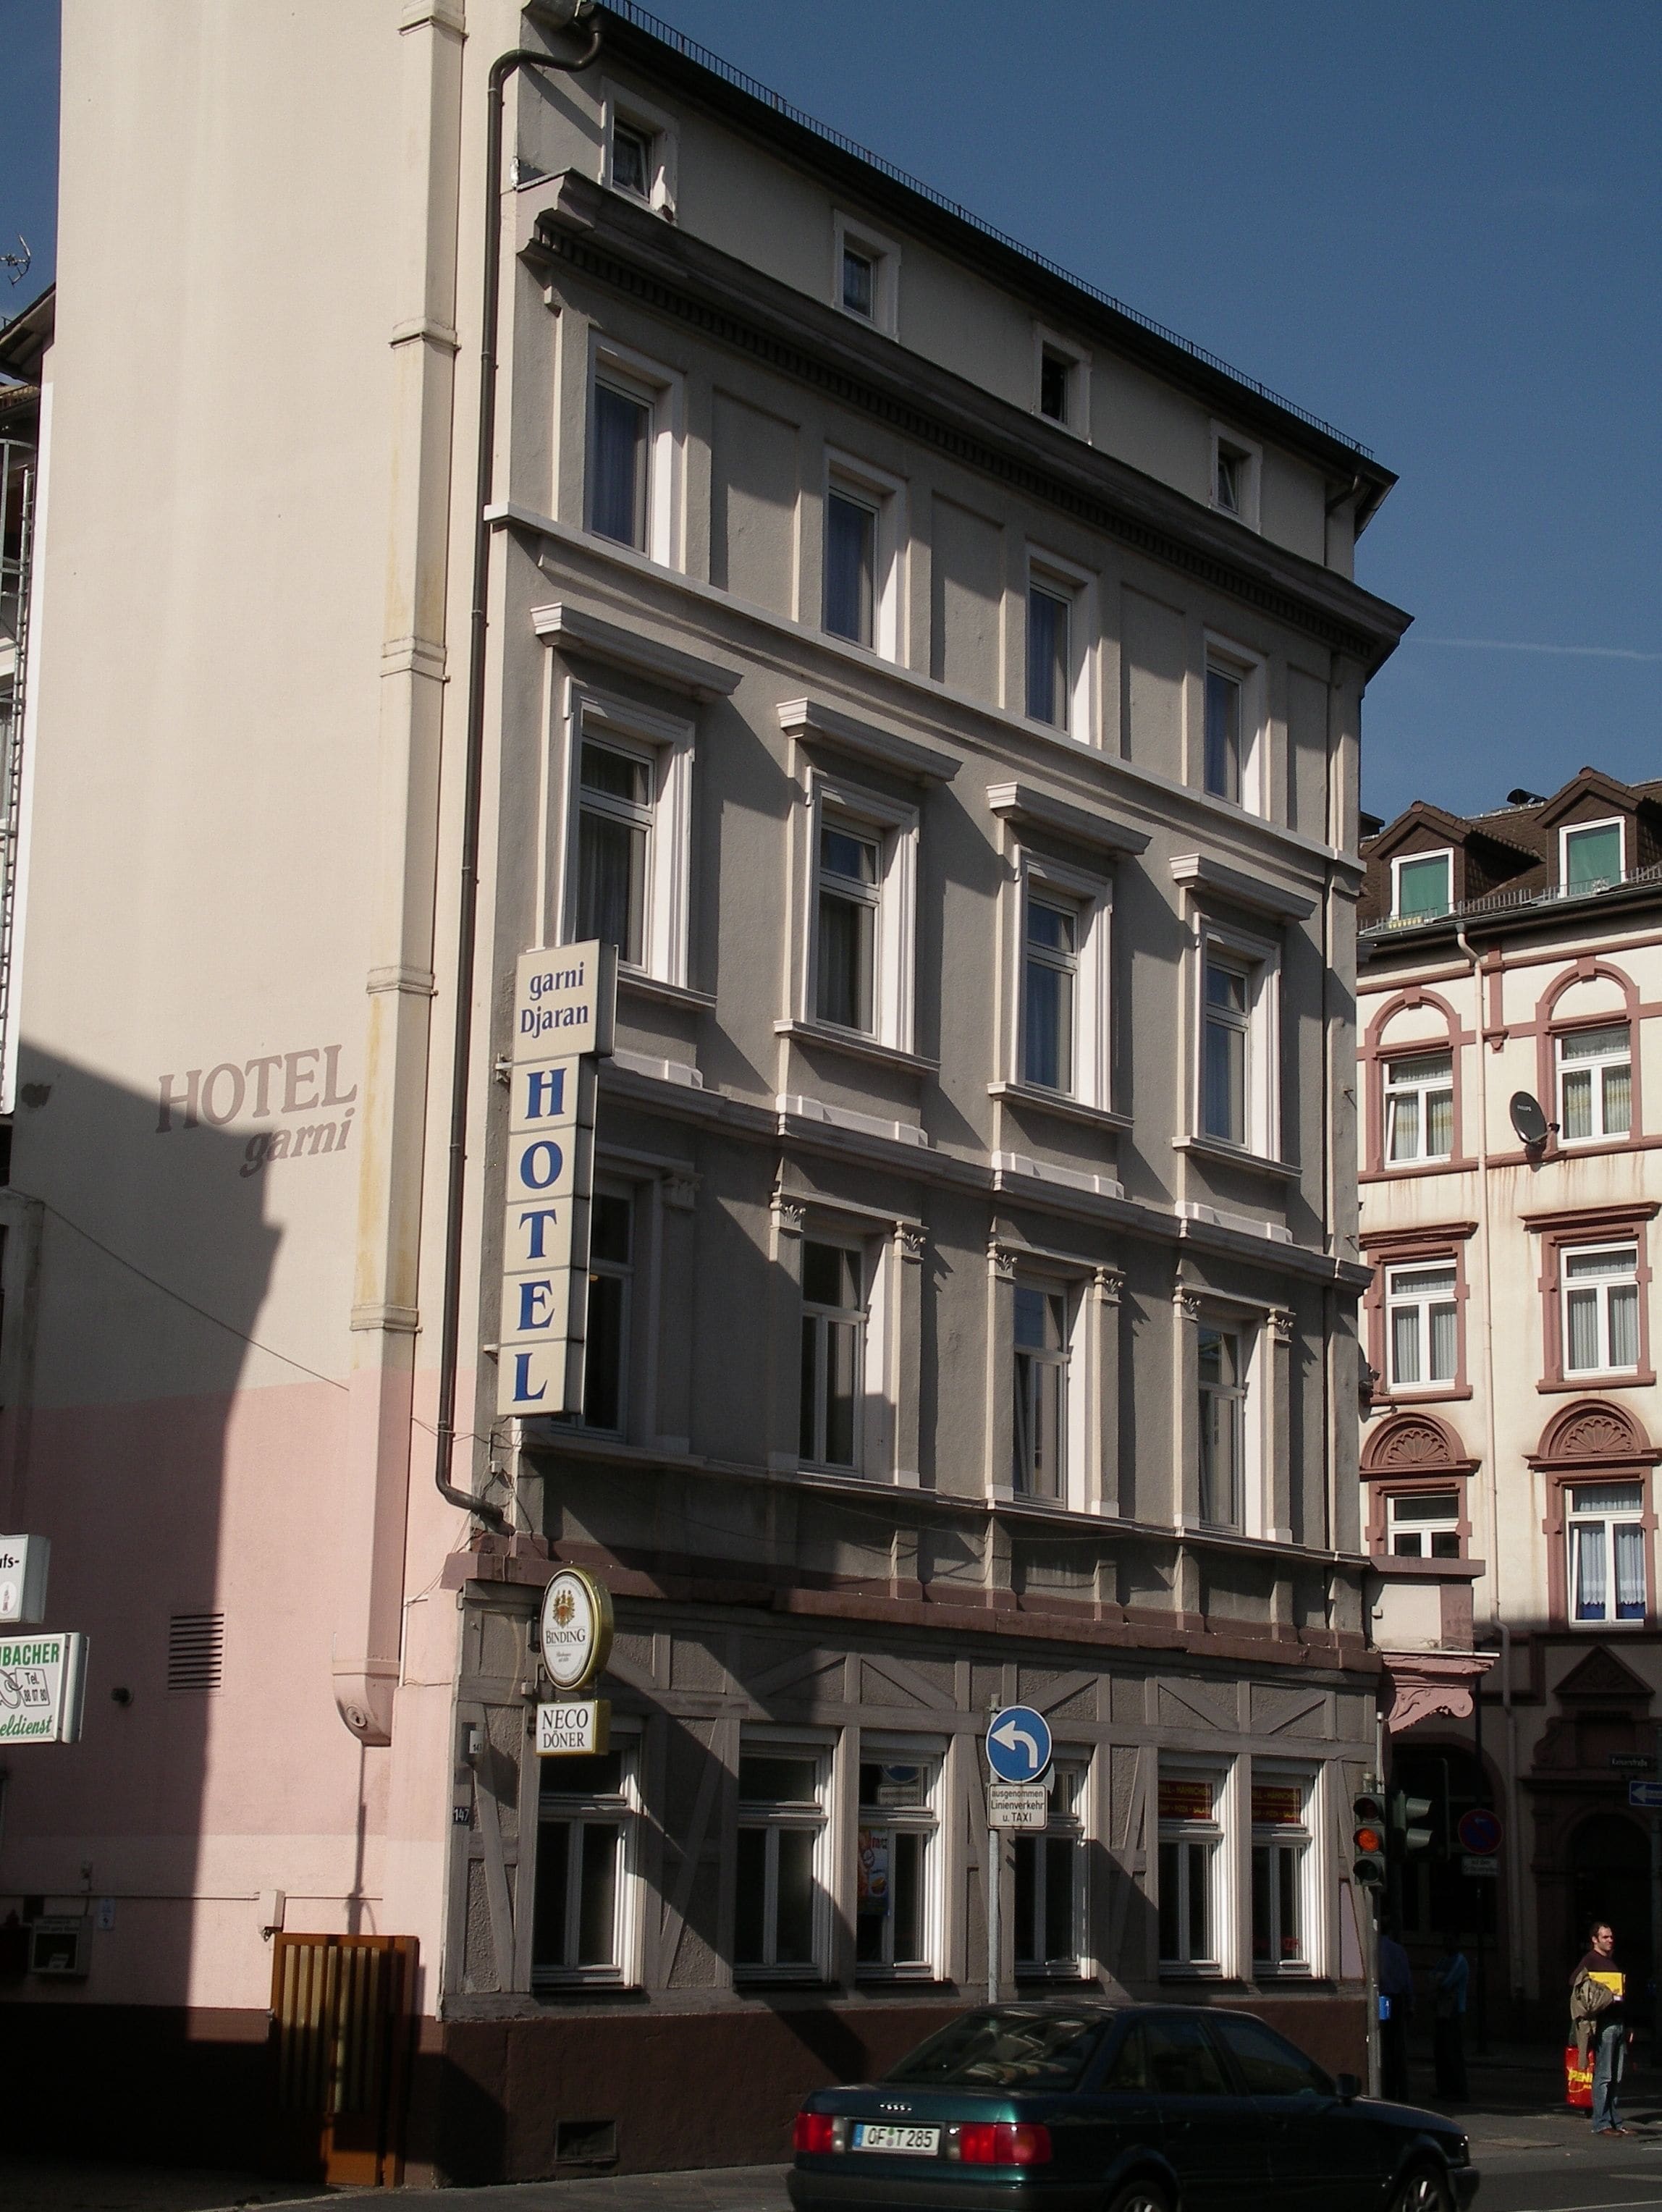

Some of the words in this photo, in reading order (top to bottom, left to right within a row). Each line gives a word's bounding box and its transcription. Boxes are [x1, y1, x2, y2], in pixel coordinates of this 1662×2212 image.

[529, 961, 585, 1002] garni
[520, 1005, 589, 1039] Djaran
[155, 1044, 358, 1134] HOTEL
[239, 1107, 355, 1178] garni
[512, 1067, 568, 1403] HOTEL
[546, 1628, 586, 1645] BINDING
[542, 1708, 589, 1730] NECO
[543, 1731, 585, 1748] DÖNER
[991, 1790, 1043, 1799] ausgenommen
[991, 1799, 1045, 1810] Linienverkehr
[455, 1808, 470, 1821] 147
[1011, 1812, 1032, 1822] TAXI
[867, 2127, 887, 2145] OF
[906, 2130, 933, 2148] 285
